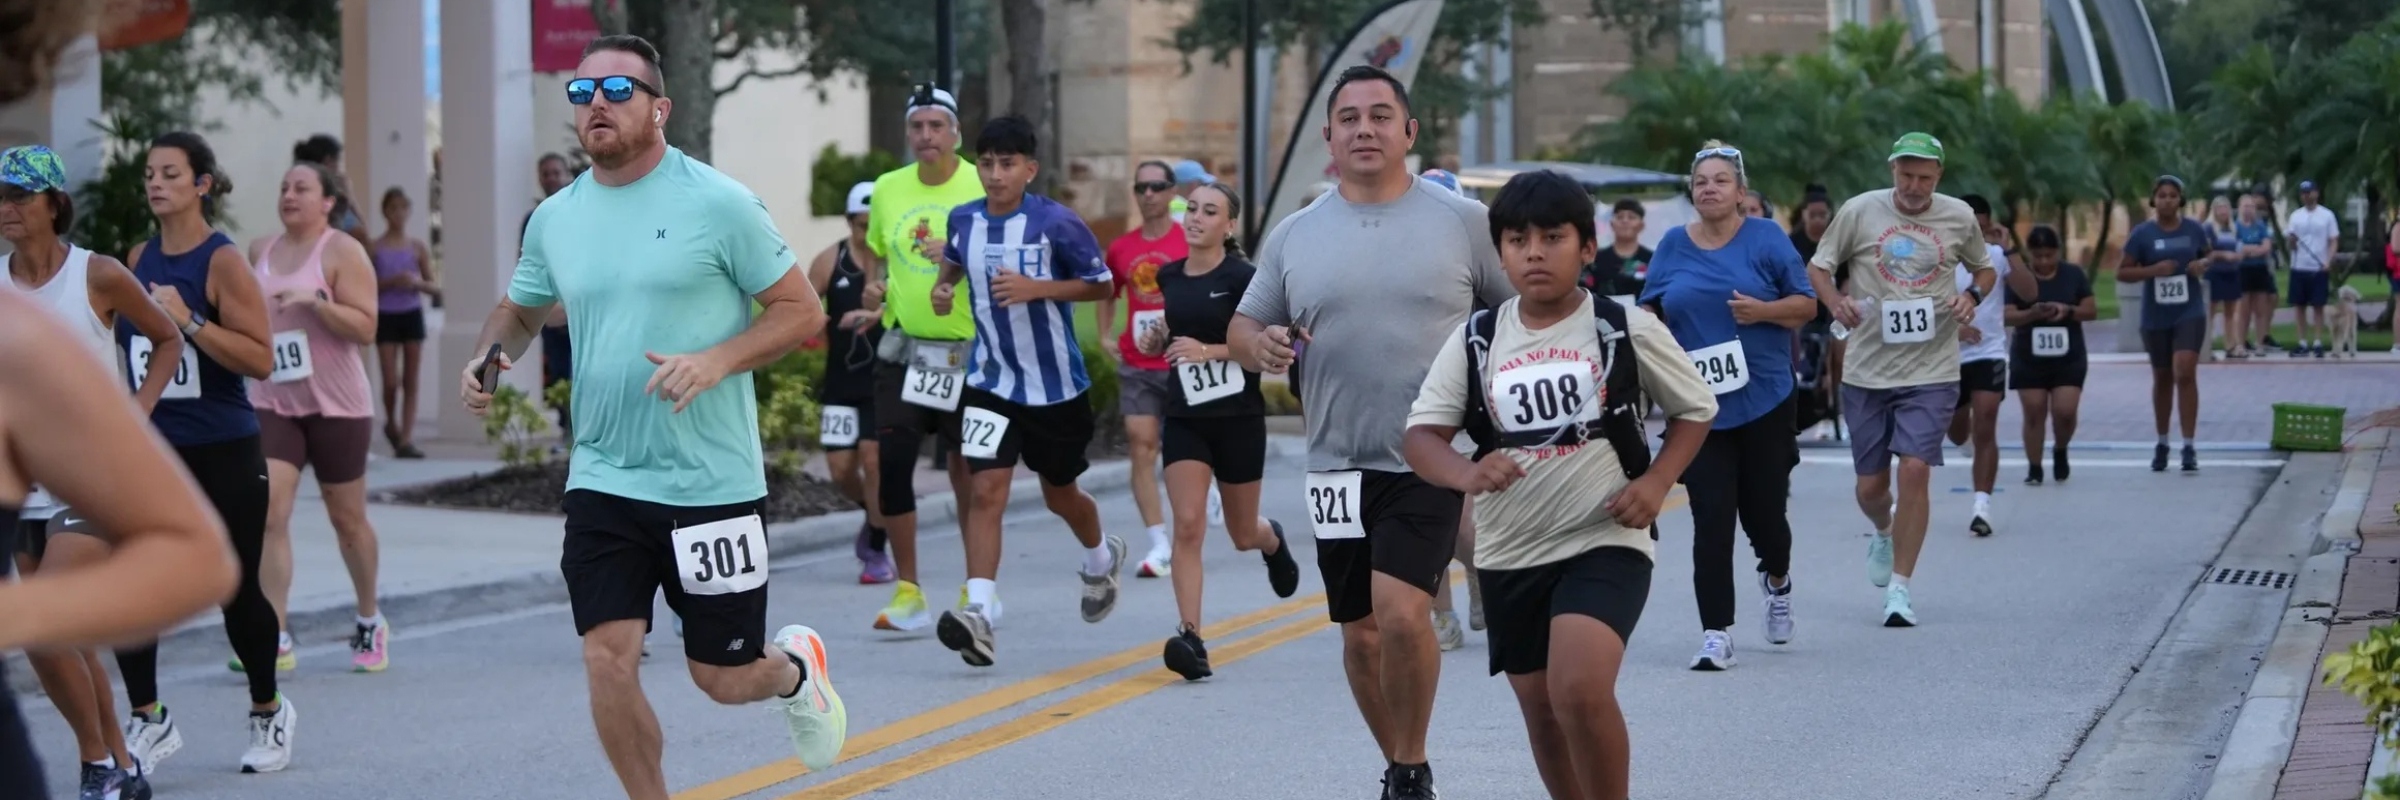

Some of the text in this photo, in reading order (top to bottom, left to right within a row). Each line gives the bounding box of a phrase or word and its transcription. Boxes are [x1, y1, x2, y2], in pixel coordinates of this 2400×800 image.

[1016, 247, 1045, 277] H
[2160, 281, 2184, 298] 328
[1890, 308, 1928, 334] 313
[139, 350, 188, 386] 30
[273, 341, 302, 372] 19
[1526, 350, 1544, 362] NO
[1549, 347, 1582, 362] PAIN
[1695, 353, 1739, 385] 294
[914, 370, 954, 399] 329
[1188, 360, 1228, 392] 317
[1509, 373, 1582, 425] 308
[1310, 486, 1352, 525] 321
[690, 533, 756, 583] 301
